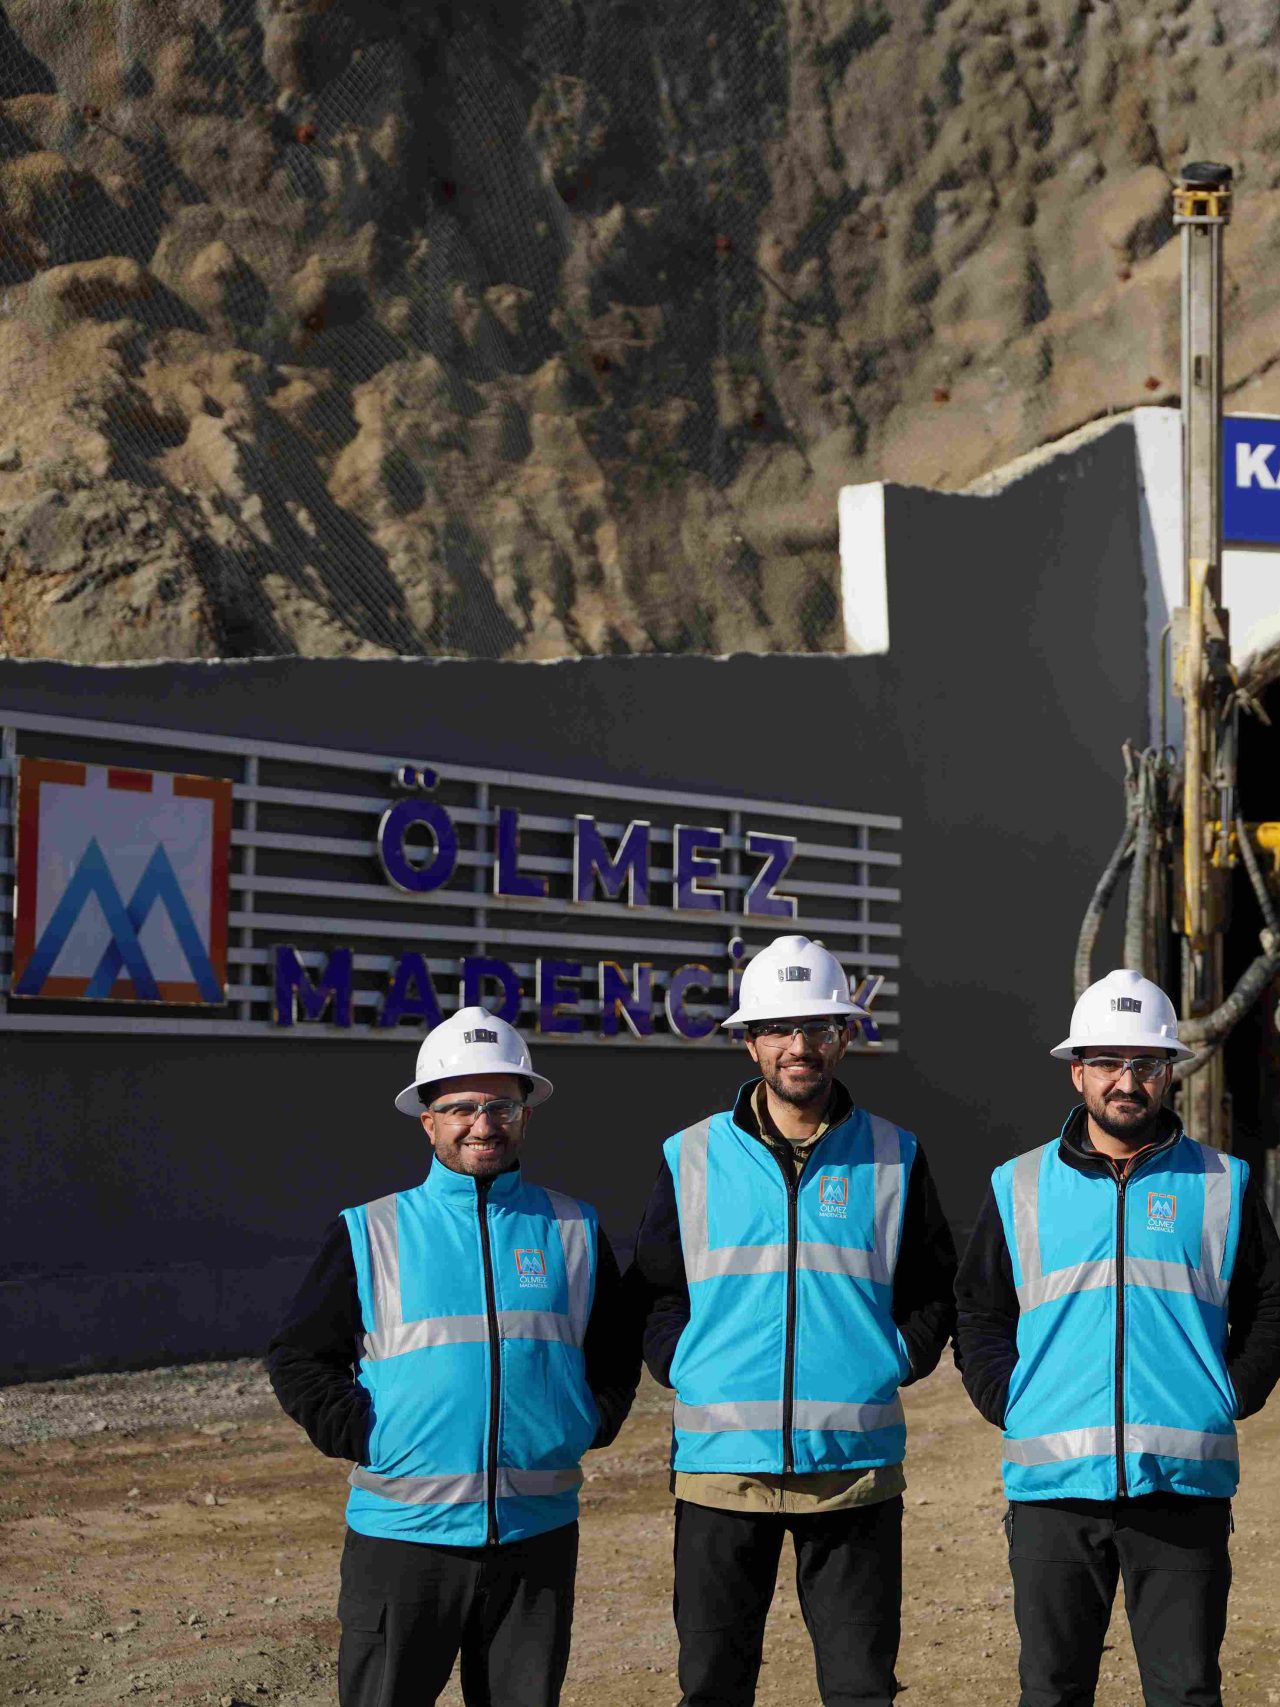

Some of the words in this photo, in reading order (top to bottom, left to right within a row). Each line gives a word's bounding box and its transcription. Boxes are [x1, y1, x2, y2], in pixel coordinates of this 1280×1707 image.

[377, 764, 798, 920] ÖLMEZ
[273, 937, 884, 1047] MADENCİK
[820, 1203, 847, 1214] ÖLMEZ
[1147, 1218, 1175, 1229] ÖLMEZ
